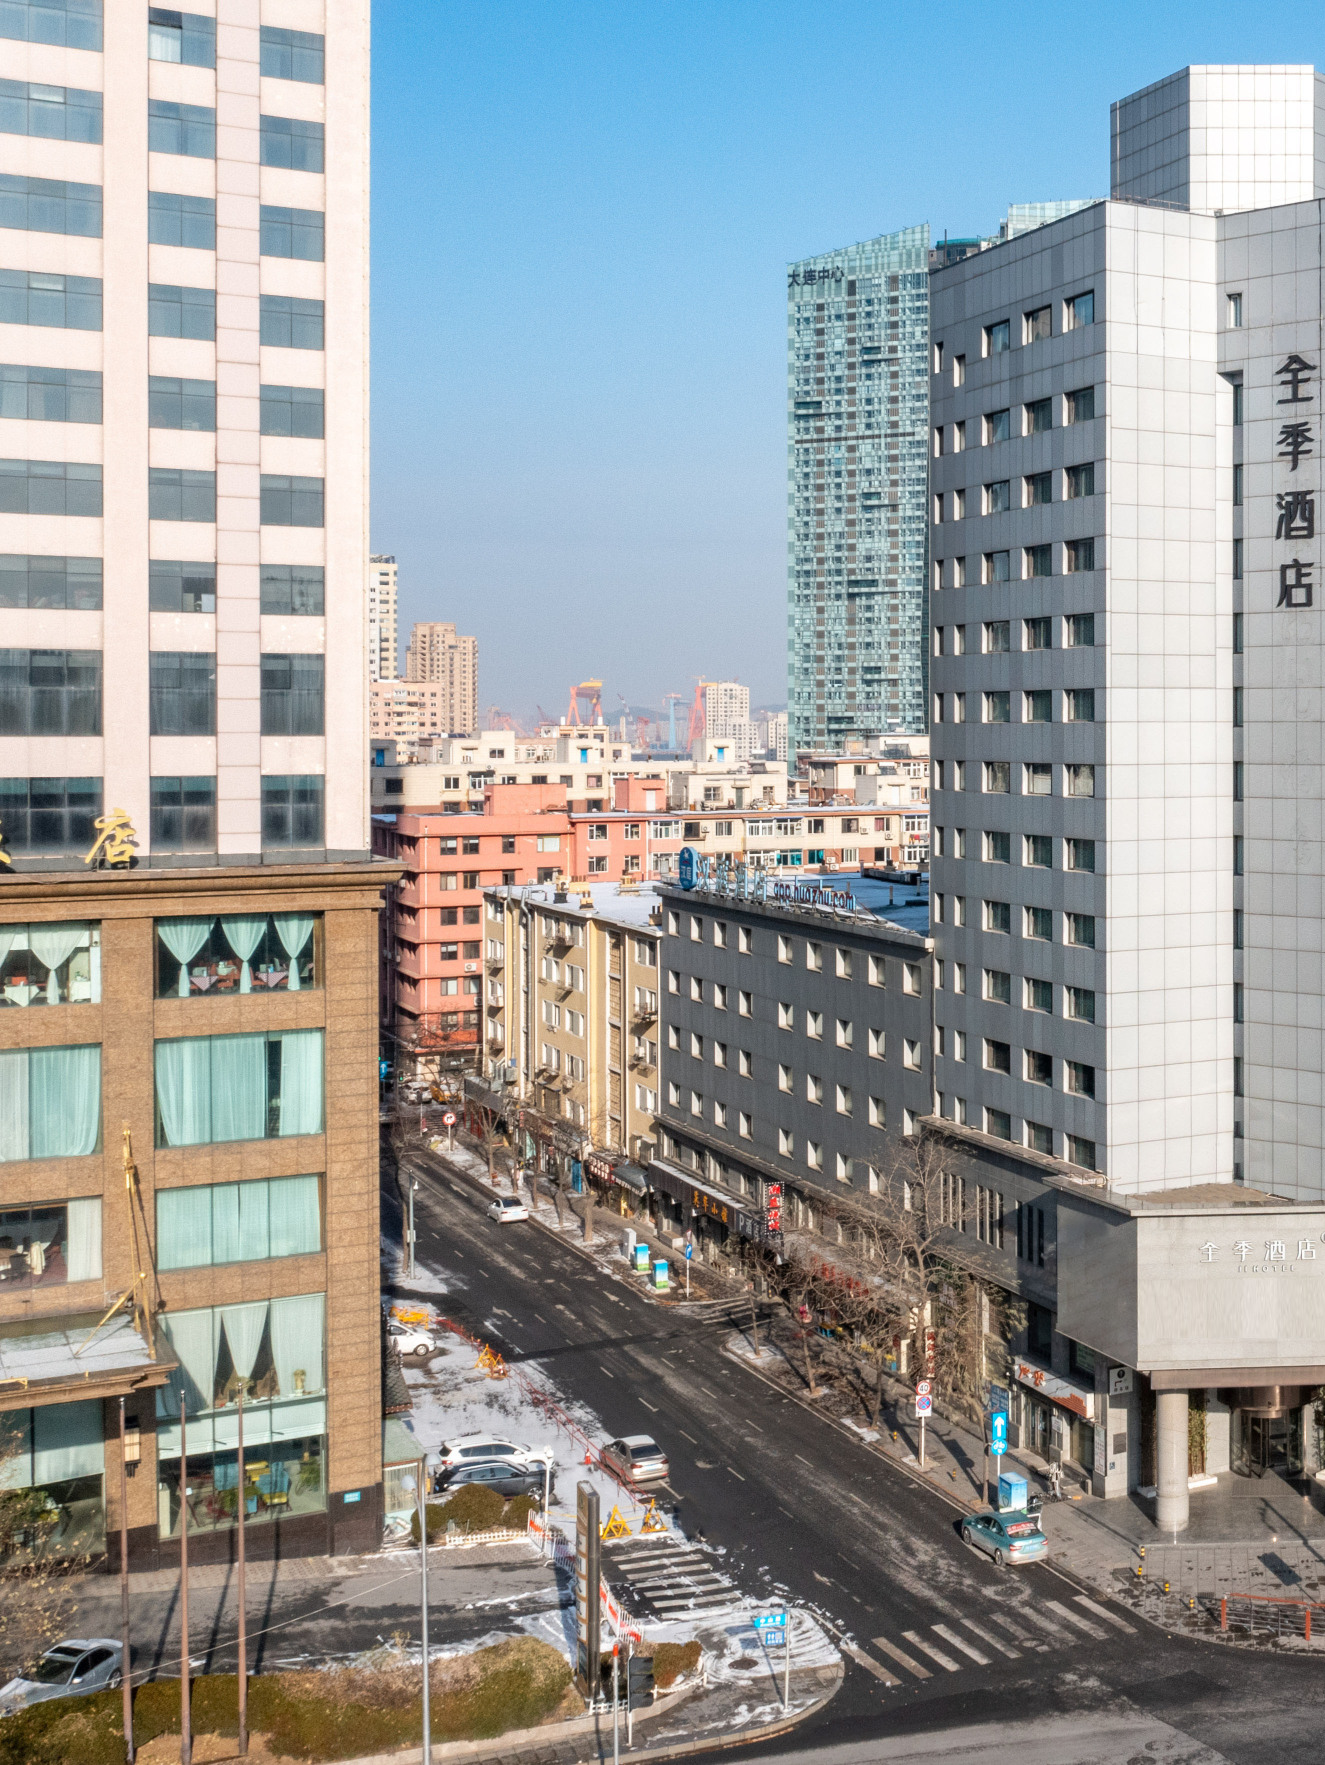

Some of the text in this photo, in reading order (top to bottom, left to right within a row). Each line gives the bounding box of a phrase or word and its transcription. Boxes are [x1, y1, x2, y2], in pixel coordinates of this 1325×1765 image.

[1275, 354, 1317, 609] 全季酒店
[1199, 1239, 1317, 1263] 全季酒店
[1251, 1265, 1296, 1273] HOTEL
[919, 1384, 929, 1393] 40
